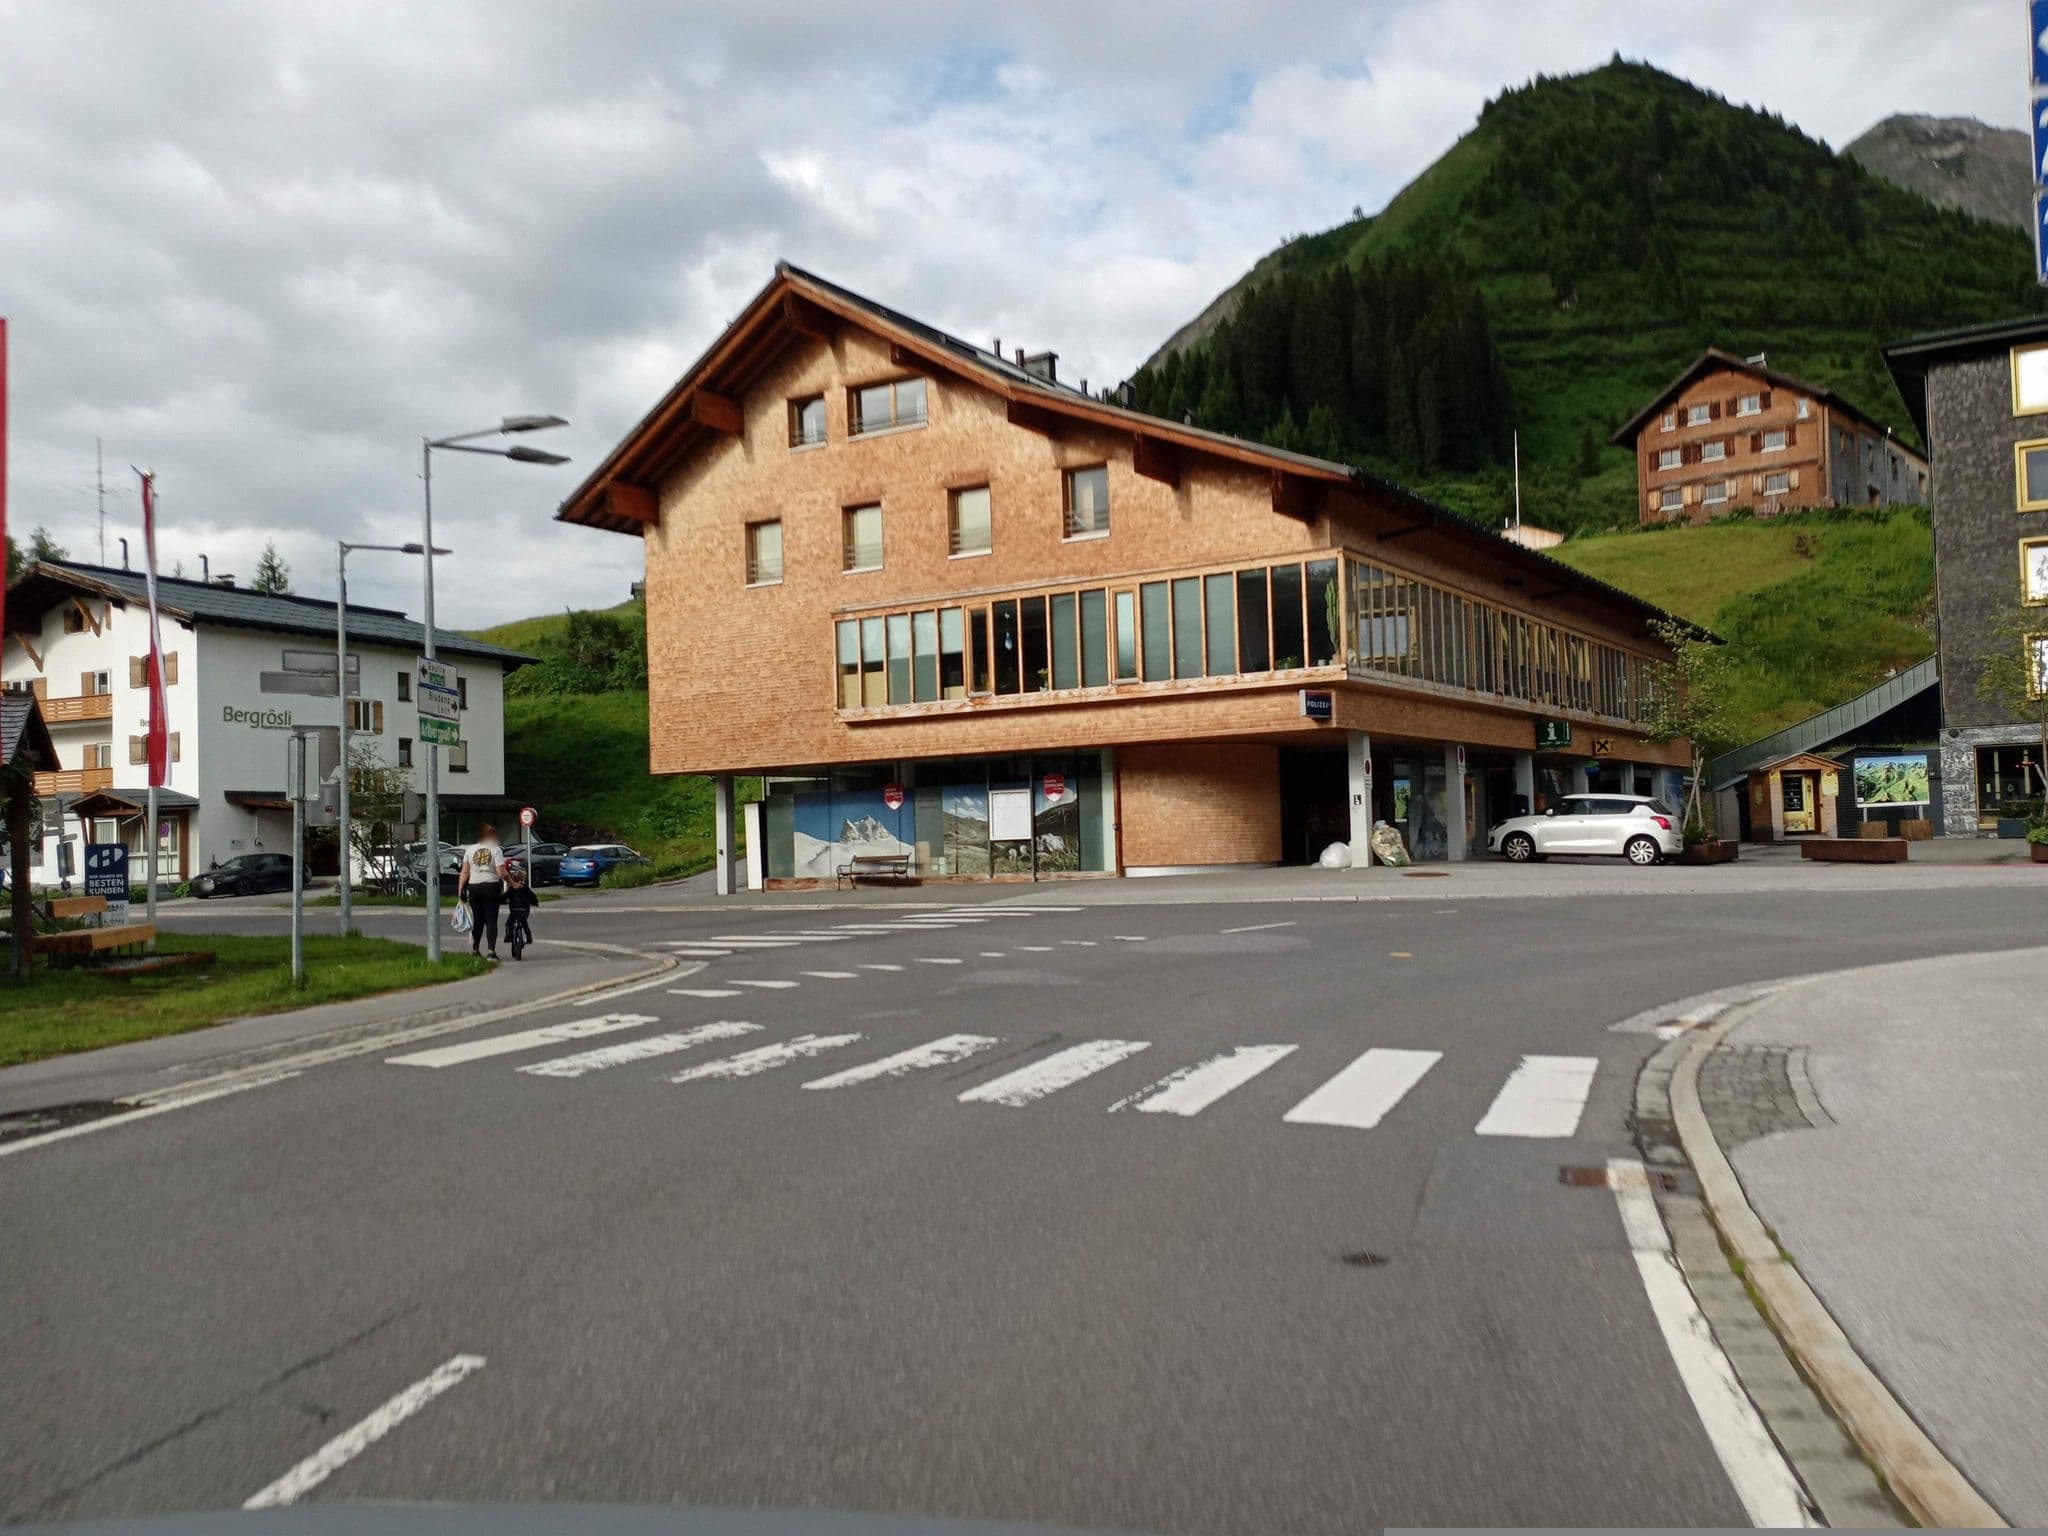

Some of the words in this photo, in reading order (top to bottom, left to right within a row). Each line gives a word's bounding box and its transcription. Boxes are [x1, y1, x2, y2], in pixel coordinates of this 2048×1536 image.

[223, 705, 292, 728] Bergrösli
[89, 879, 124, 888] BESTEN
[89, 887, 124, 895] KUNDEN
